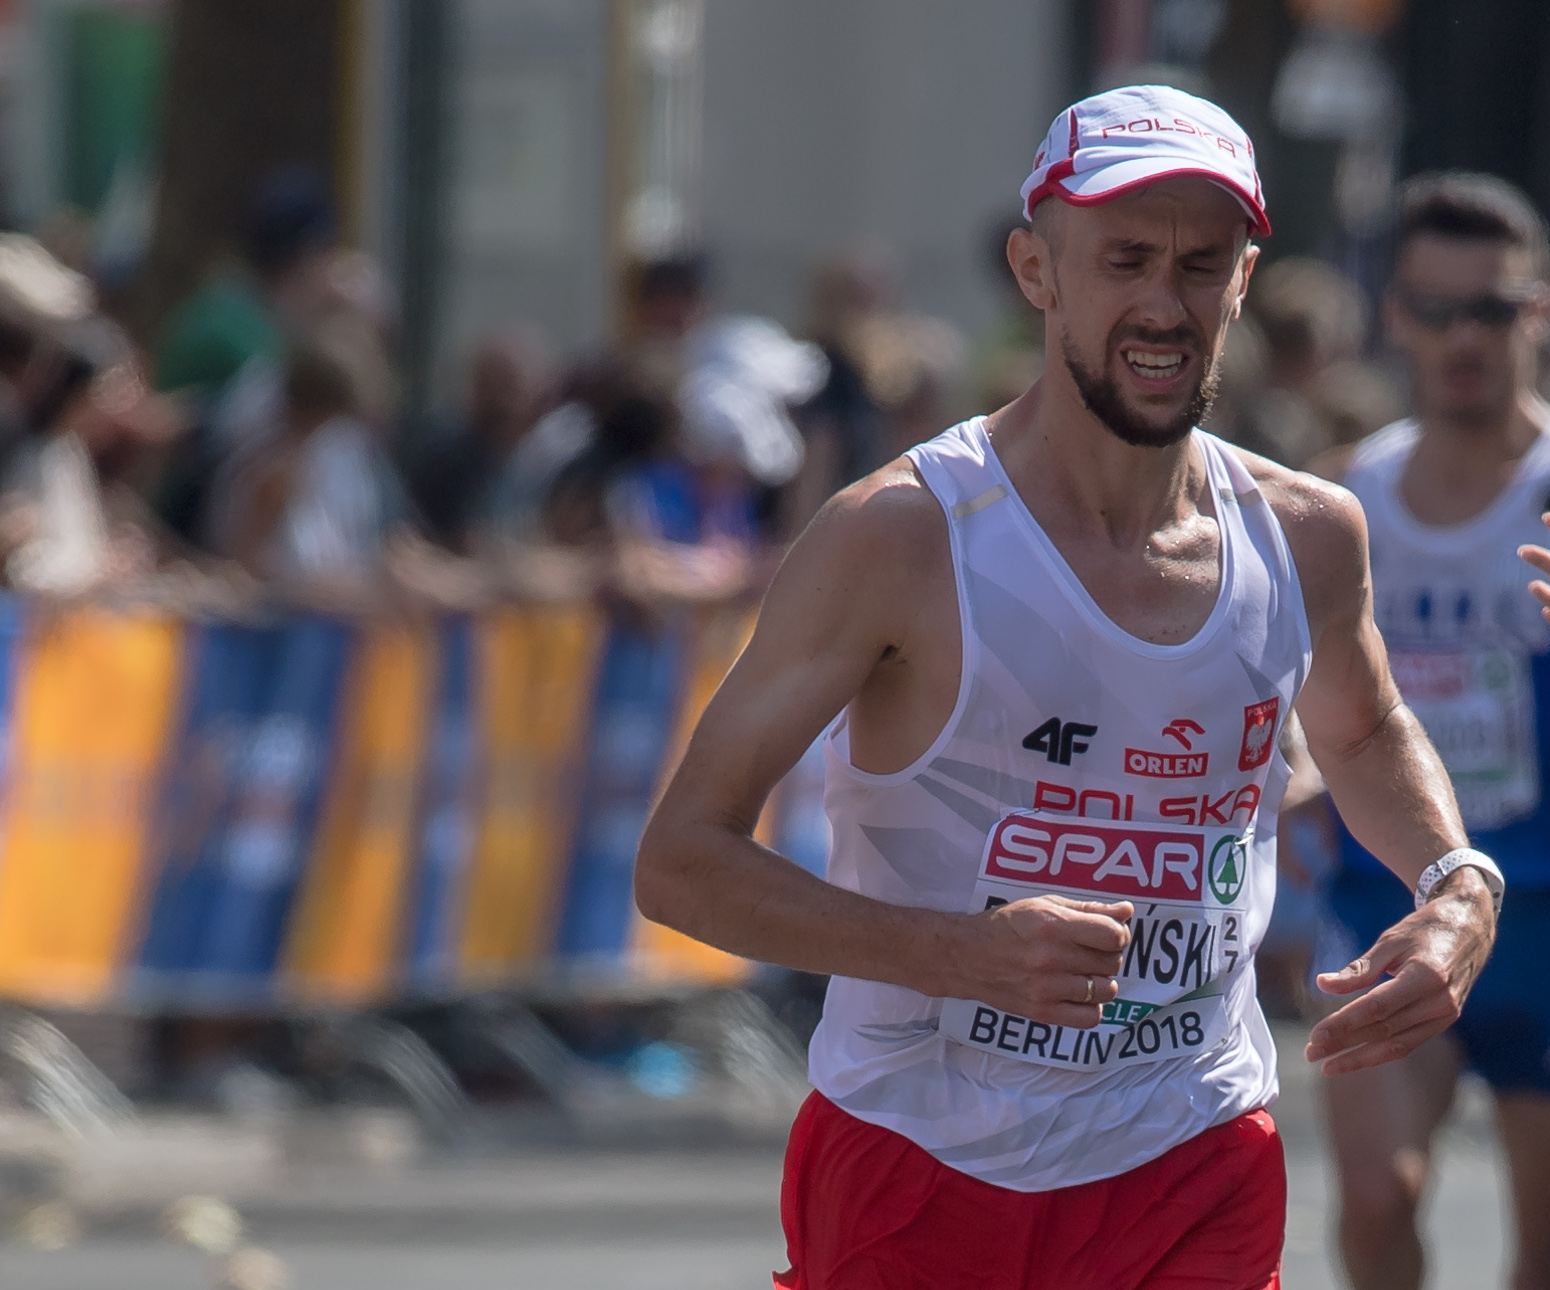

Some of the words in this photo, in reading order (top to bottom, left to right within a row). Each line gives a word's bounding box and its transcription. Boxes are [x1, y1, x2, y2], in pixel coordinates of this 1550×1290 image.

[1103, 118, 1236, 159] POLSKA
[1247, 702, 1277, 718] POLSKA
[1022, 716, 1098, 766] 4F
[1129, 753, 1204, 775] ORLEN
[1033, 781, 1261, 827] POLSKA
[995, 824, 1199, 892] SPAR
[968, 1006, 1116, 1066] BERLIN
[1118, 1011, 1205, 1060] 2018
